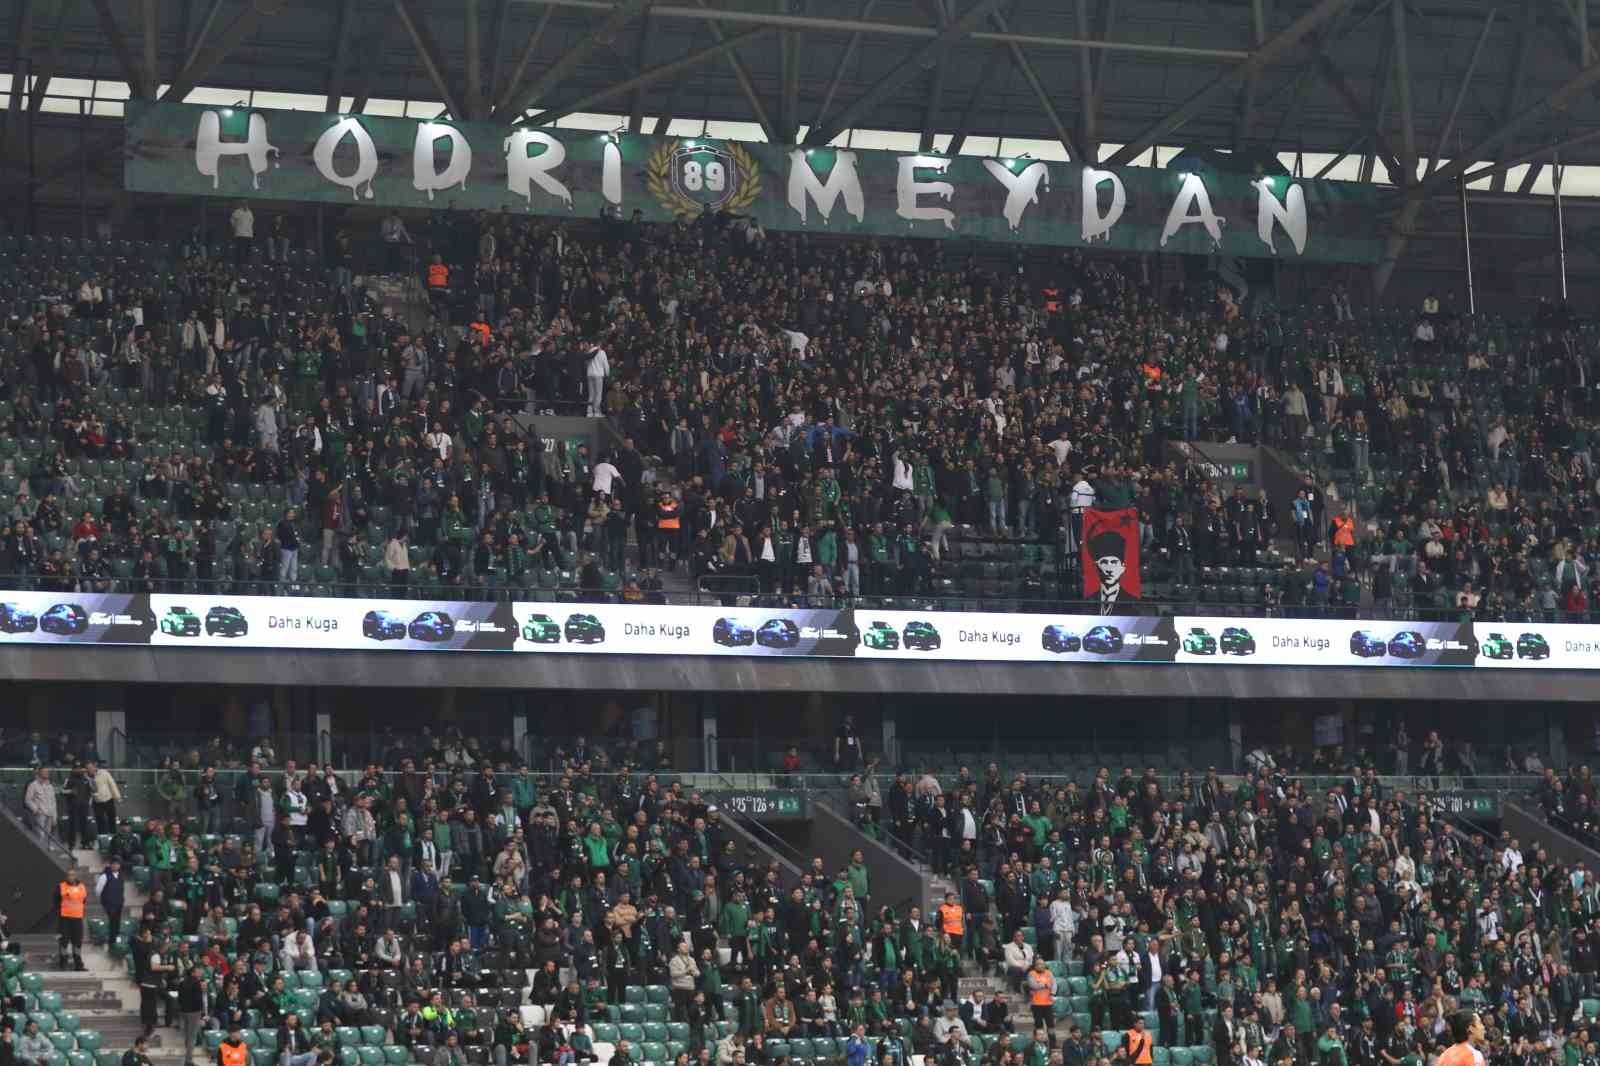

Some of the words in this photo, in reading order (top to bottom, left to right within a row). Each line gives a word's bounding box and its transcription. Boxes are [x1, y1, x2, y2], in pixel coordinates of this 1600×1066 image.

[684, 161, 725, 191] 89
[788, 148, 1308, 254] MEYDAN
[268, 614, 300, 629] Daha
[306, 616, 338, 633] Kuga
[624, 621, 655, 635] Daha
[659, 624, 690, 640] Kuga
[959, 629, 988, 642] Daha
[992, 631, 1021, 646] Kuga
[1272, 634, 1300, 648] Daha
[1303, 636, 1330, 651] Kuga
[1565, 640, 1591, 652] Daha
